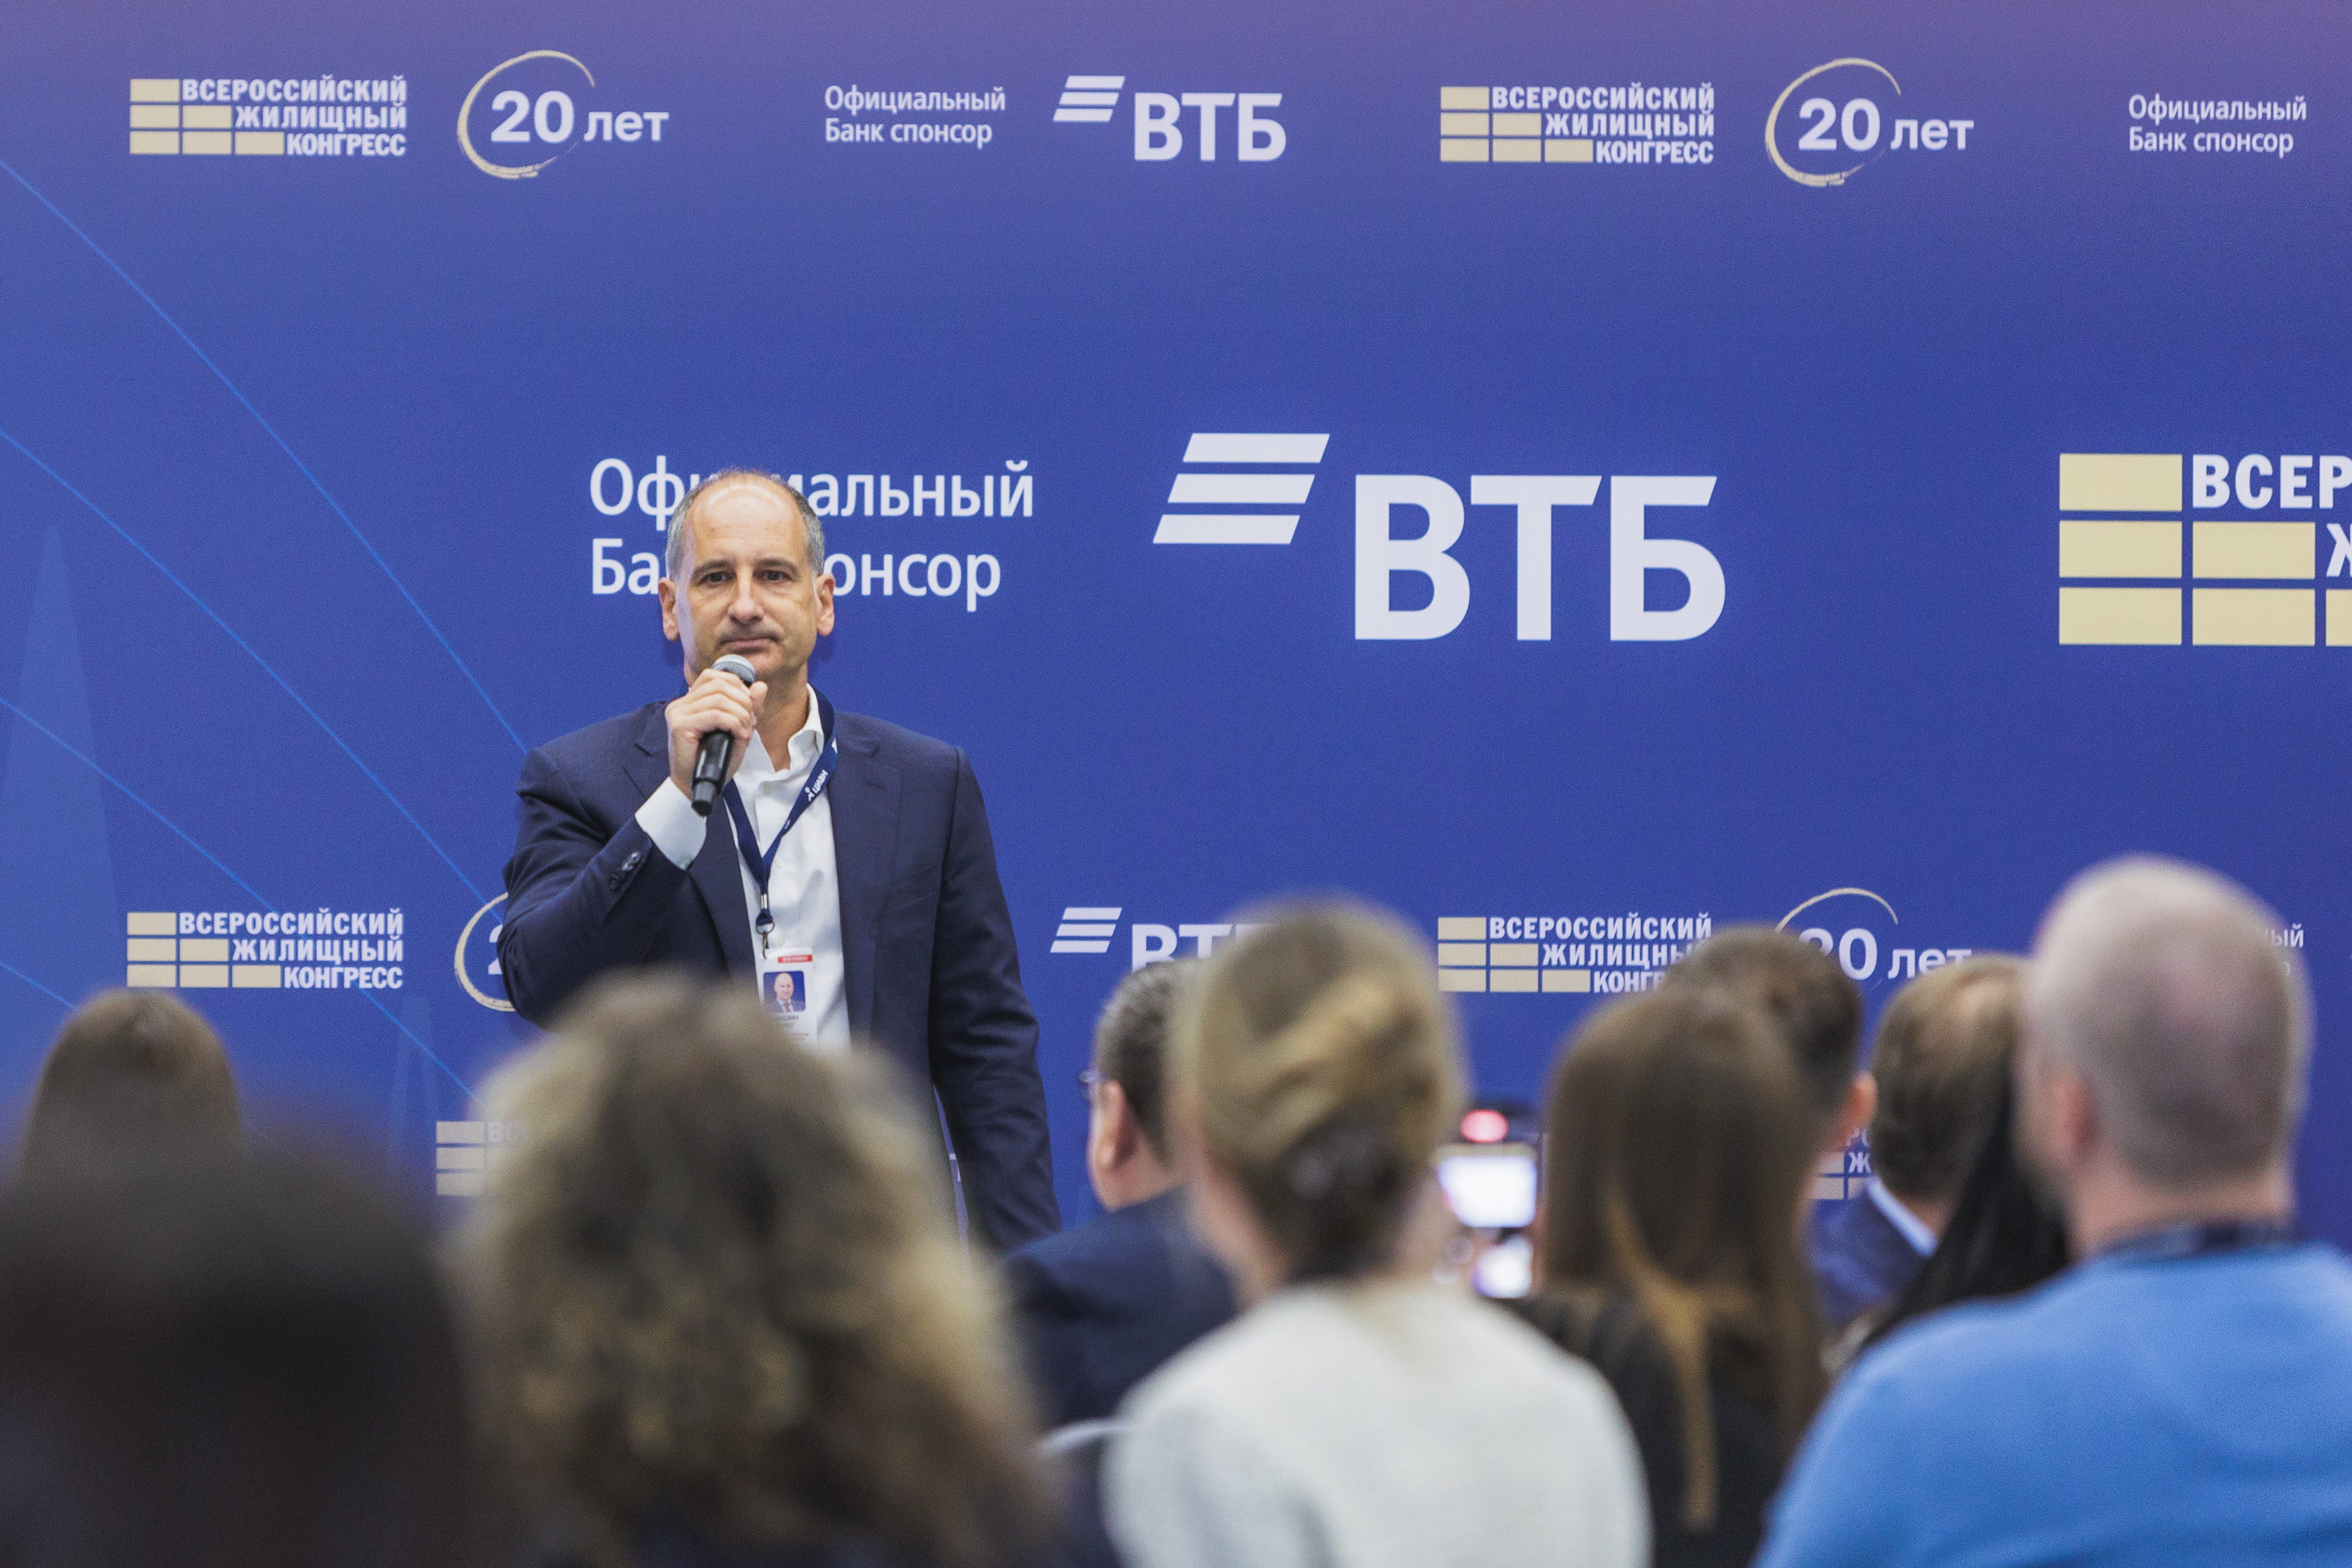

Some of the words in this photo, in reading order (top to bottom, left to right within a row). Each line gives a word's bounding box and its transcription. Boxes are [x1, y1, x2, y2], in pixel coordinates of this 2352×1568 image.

[182, 75, 407, 102] ВСЕРОССИЙСКИЙ
[824, 84, 1006, 116] Официальный
[1492, 82, 1715, 111] ВСЕРОССИЙСКИЙ
[235, 101, 407, 132] ЖИЛИЩНЫЙ
[490, 90, 574, 143] 20
[584, 111, 670, 142] лет
[1545, 109, 1715, 139] ЖИЛИЩНЫЙ
[1798, 98, 1881, 151] 20
[1890, 119, 1975, 150] лет
[2128, 93, 2307, 126] Официальный
[825, 117, 884, 142] Банк
[890, 123, 993, 149] спонсор
[1134, 92, 1287, 161] ВТБ
[286, 133, 406, 156] КОНГРЕСС
[1595, 141, 1714, 164] КОНГРЕСС
[2129, 126, 2187, 152] Банк
[2193, 132, 2294, 159] спонсор
[590, 455, 1033, 530] Офальный
[1355, 474, 1726, 641] ВТБ
[592, 537, 664, 595] Ба
[824, 553, 1001, 612] онсор
[179, 908, 403, 935] ВСЕРОССИЙСКИЙ
[1489, 912, 1712, 940] ВСЕРОССИЙСКИЙ
[232, 934, 403, 964] ЖИЛИЩНЫЙ
[1132, 923, 1273, 974] ВТ
[1542, 943, 1693, 970] ЖИЛИЩНЫ
[284, 966, 403, 989] КОНГРЕСС
[1593, 971, 1666, 994] КОНГР
